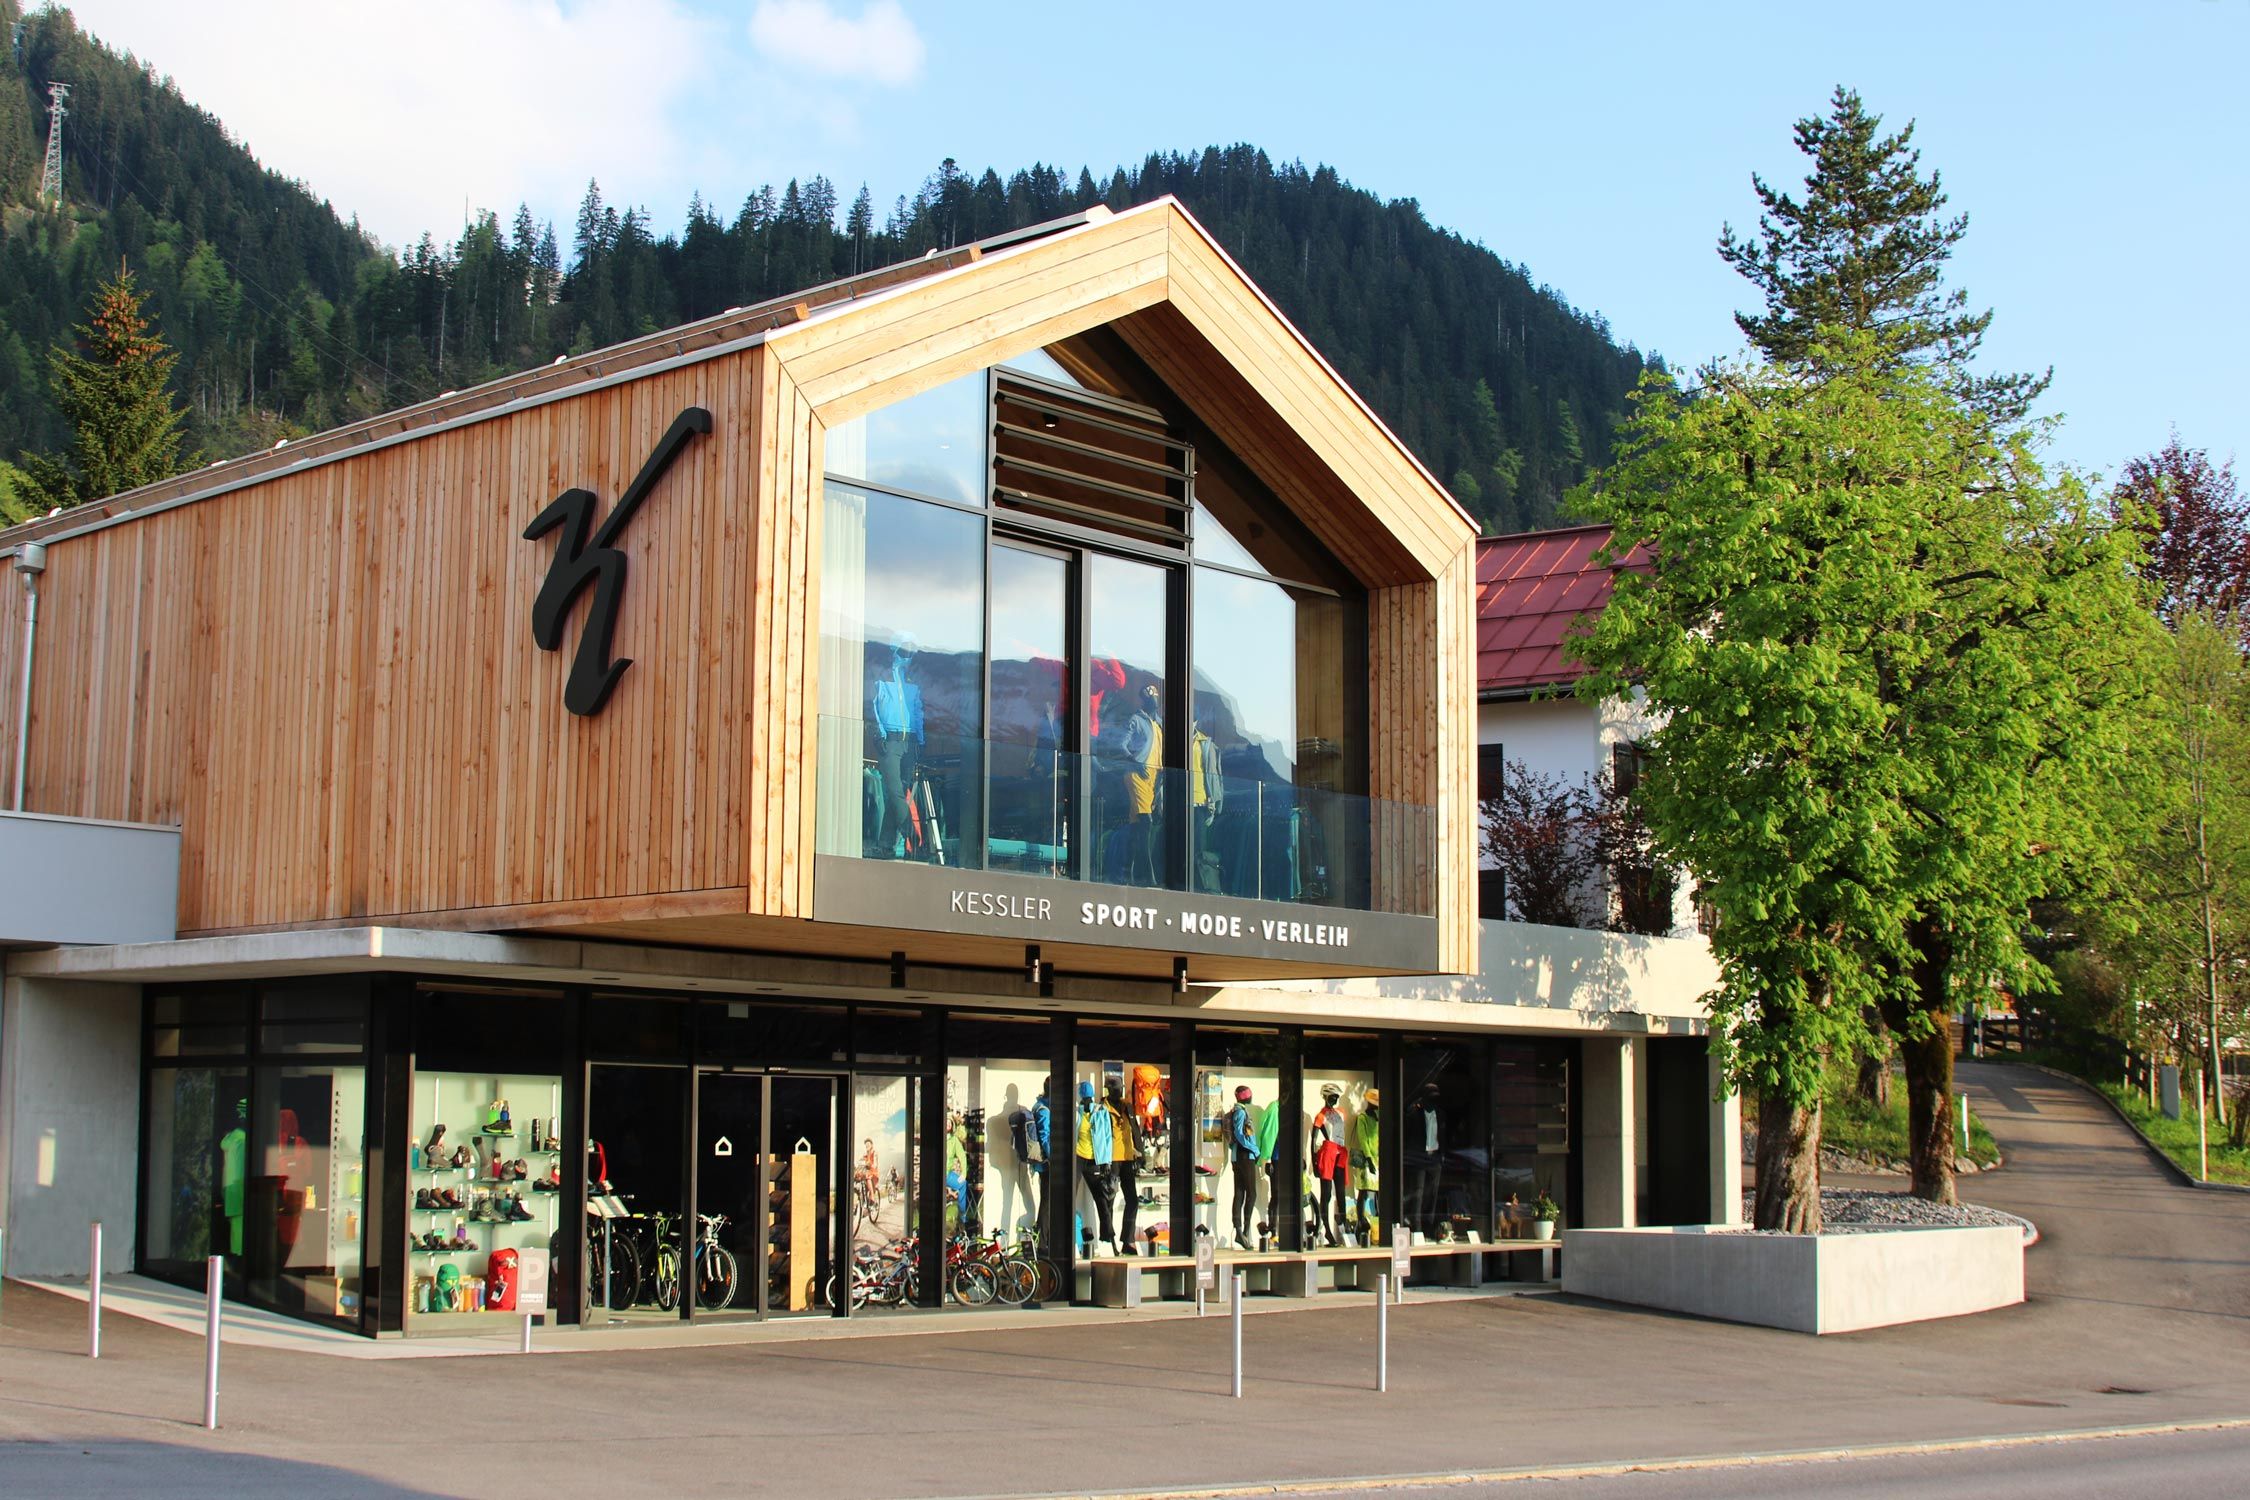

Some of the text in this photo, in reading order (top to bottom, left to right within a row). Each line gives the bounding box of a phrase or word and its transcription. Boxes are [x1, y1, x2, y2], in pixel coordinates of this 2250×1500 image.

[951, 890, 1051, 920] KESSLER
[1081, 902, 1158, 930] SPORT
[1180, 911, 1242, 938] MODE
[1262, 919, 1348, 947] VERLEIH
[1199, 1243, 1212, 1270] P
[1395, 1234, 1408, 1259] P
[522, 1256, 545, 1291] P
